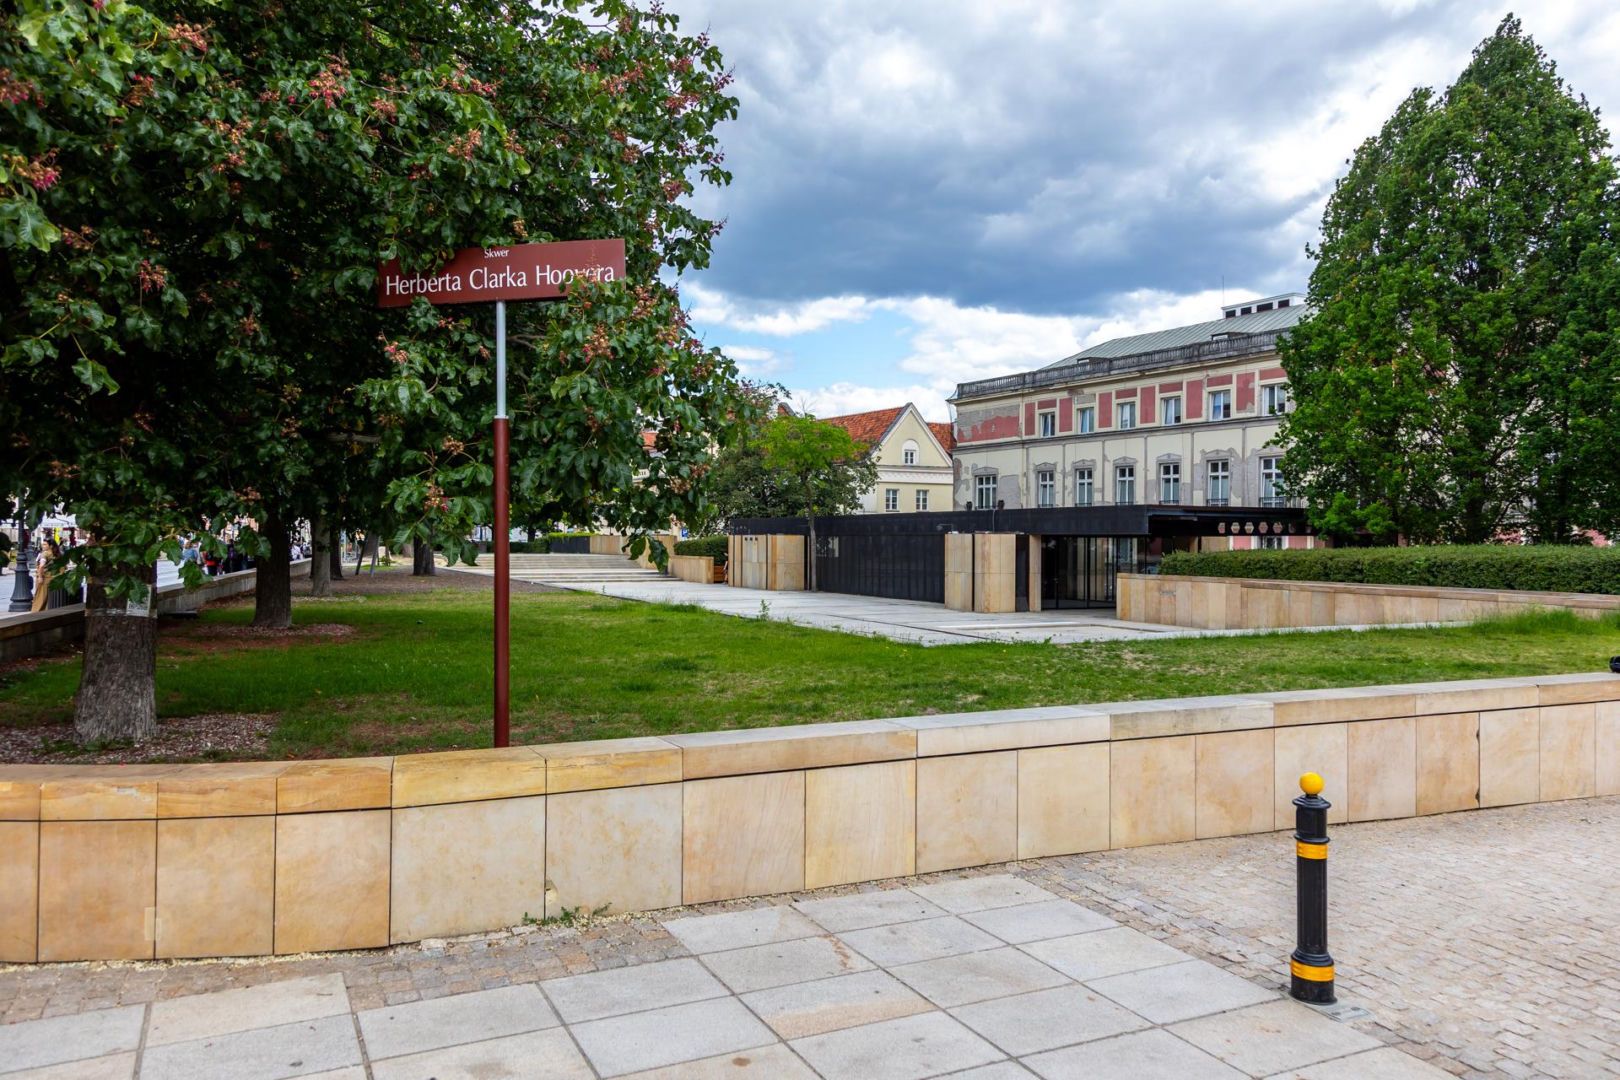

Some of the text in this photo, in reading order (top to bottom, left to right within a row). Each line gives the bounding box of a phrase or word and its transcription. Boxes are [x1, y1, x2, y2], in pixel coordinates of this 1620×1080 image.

[484, 248, 509, 258] Skwer
[386, 272, 461, 295] Herberta
[469, 264, 527, 290] Clarka
